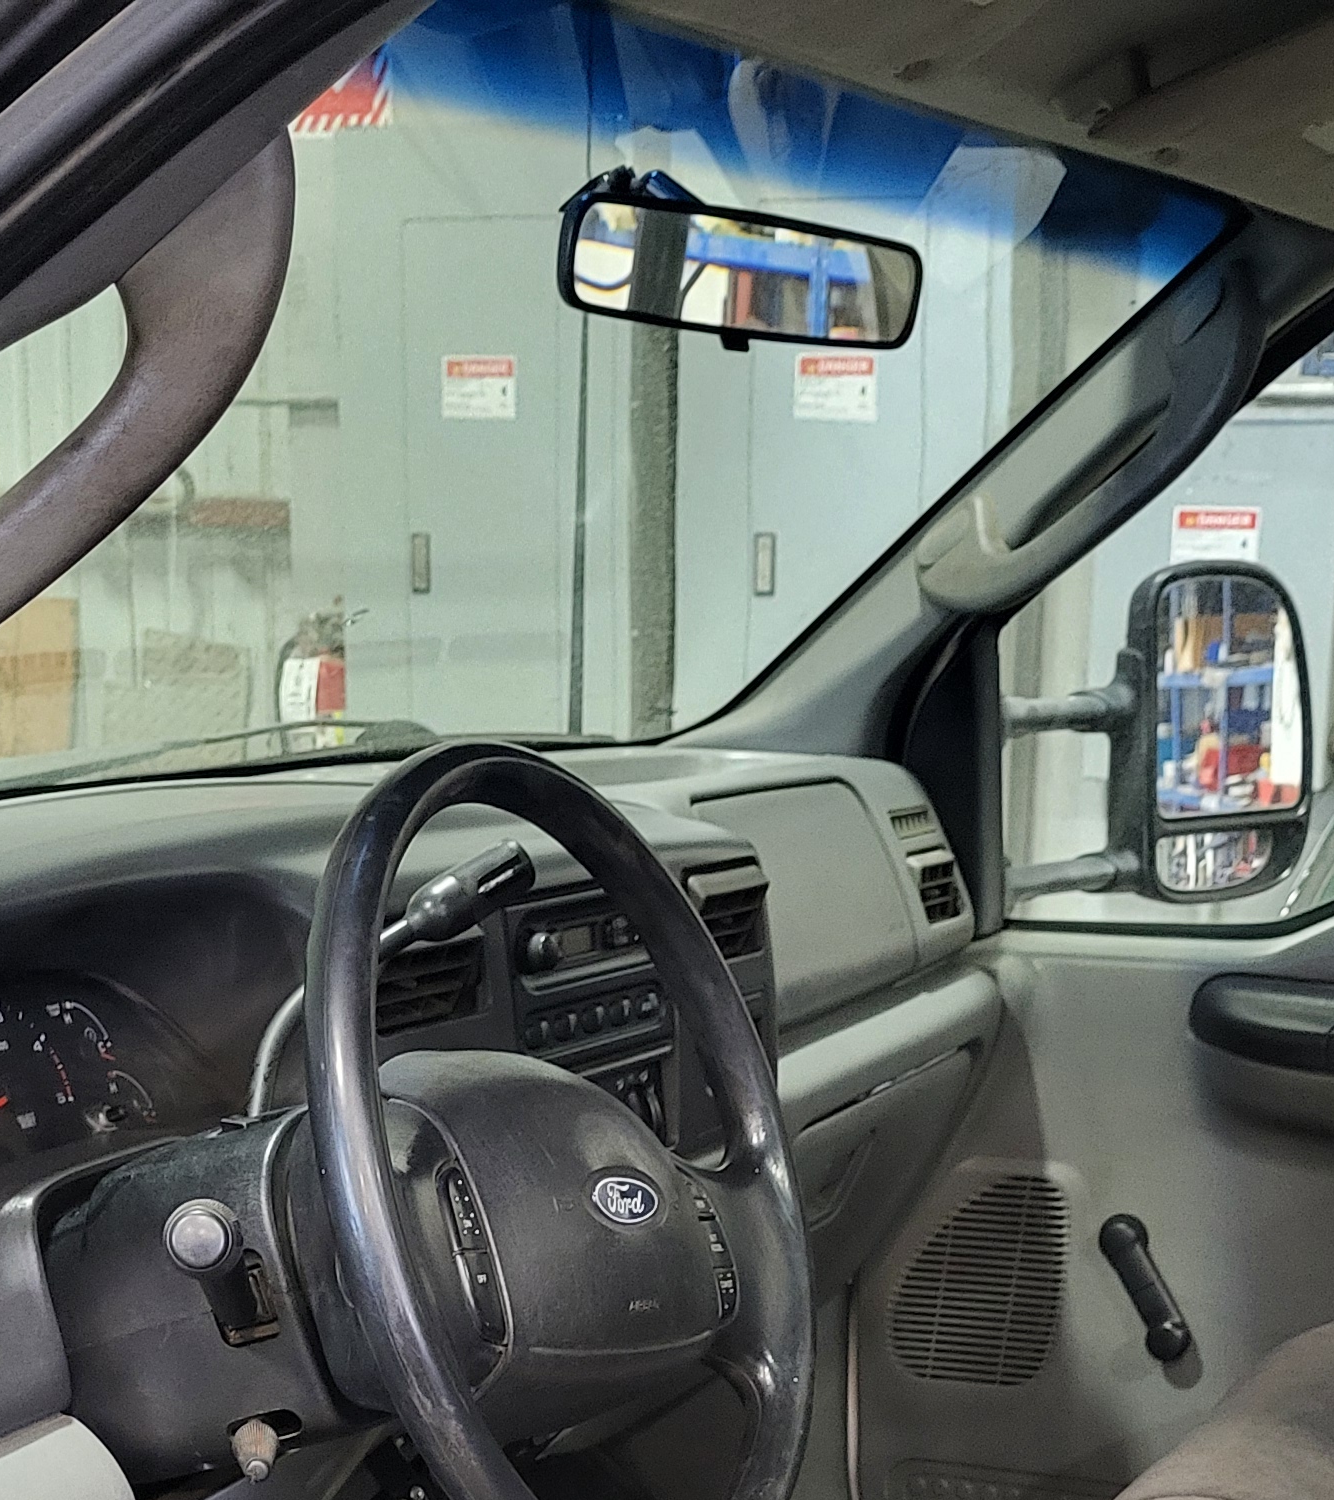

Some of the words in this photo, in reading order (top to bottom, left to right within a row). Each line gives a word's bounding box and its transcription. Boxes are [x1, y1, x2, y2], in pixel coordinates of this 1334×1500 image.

[33, 1040, 43, 1051] 4
[55, 1092, 66, 1104] 5
[606, 1181, 645, 1214] Ford
